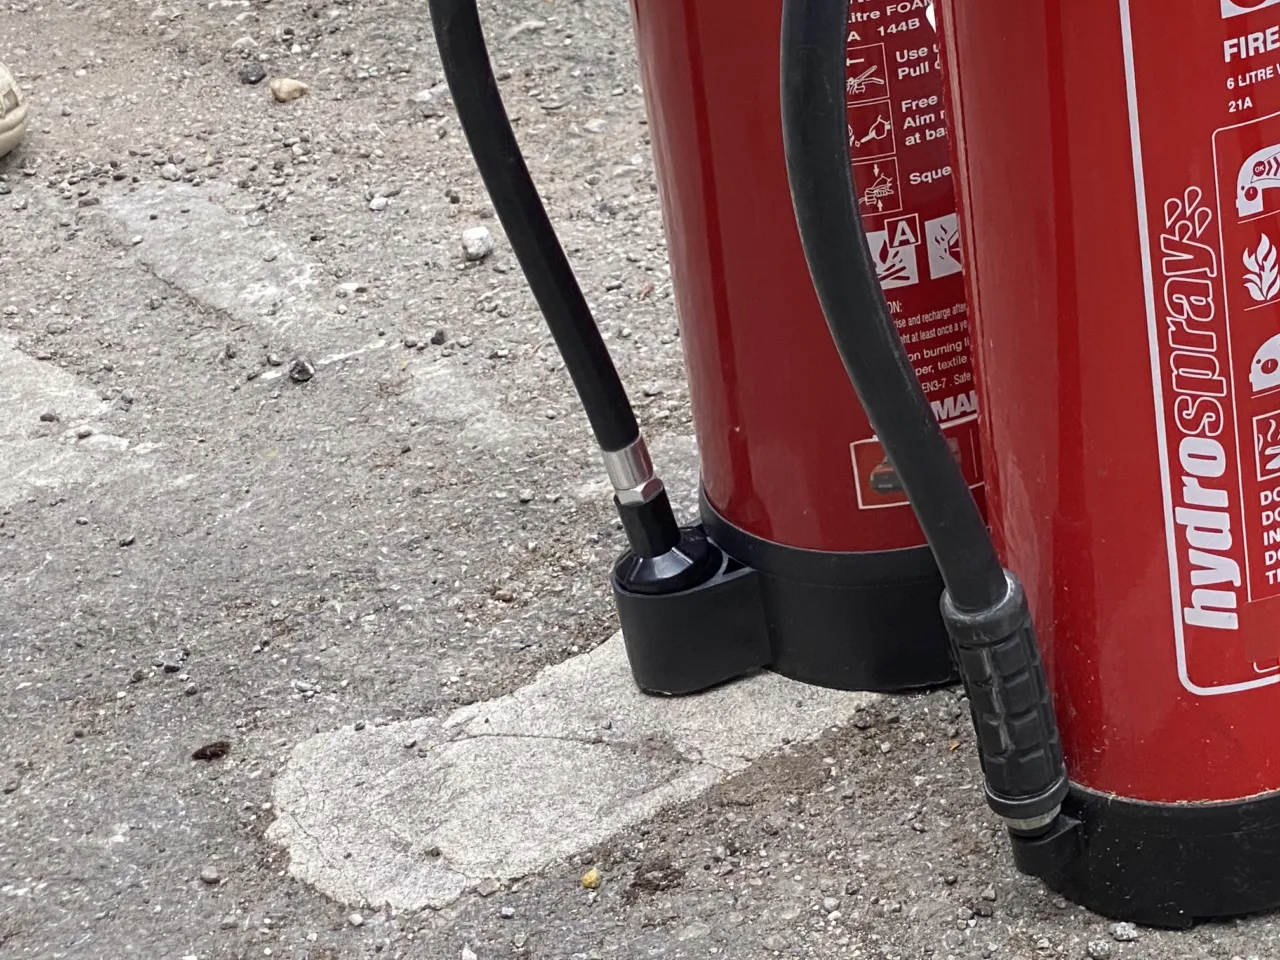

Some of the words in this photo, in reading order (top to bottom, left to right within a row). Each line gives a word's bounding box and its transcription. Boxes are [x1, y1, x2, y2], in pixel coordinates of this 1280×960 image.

[877, 18, 920, 36] 144B
[1223, 25, 1280, 63] FIRE
[896, 47, 928, 62] Use
[898, 62, 929, 79] Pull
[1227, 77, 1235, 90] 6
[1238, 66, 1274, 87] LITRE
[901, 93, 938, 113] Free
[1228, 96, 1253, 114] 21A
[903, 113, 935, 129] Aim
[905, 132, 921, 146] at
[909, 166, 951, 185] Sque
[1254, 163, 1265, 174] OK
[893, 220, 916, 247] A
[908, 314, 921, 326] and
[922, 308, 951, 323] recharge
[911, 331, 919, 342] at
[920, 328, 936, 340] least
[936, 325, 953, 336] once
[954, 323, 959, 331] a
[923, 341, 962, 358] burning
[938, 355, 967, 370] textile
